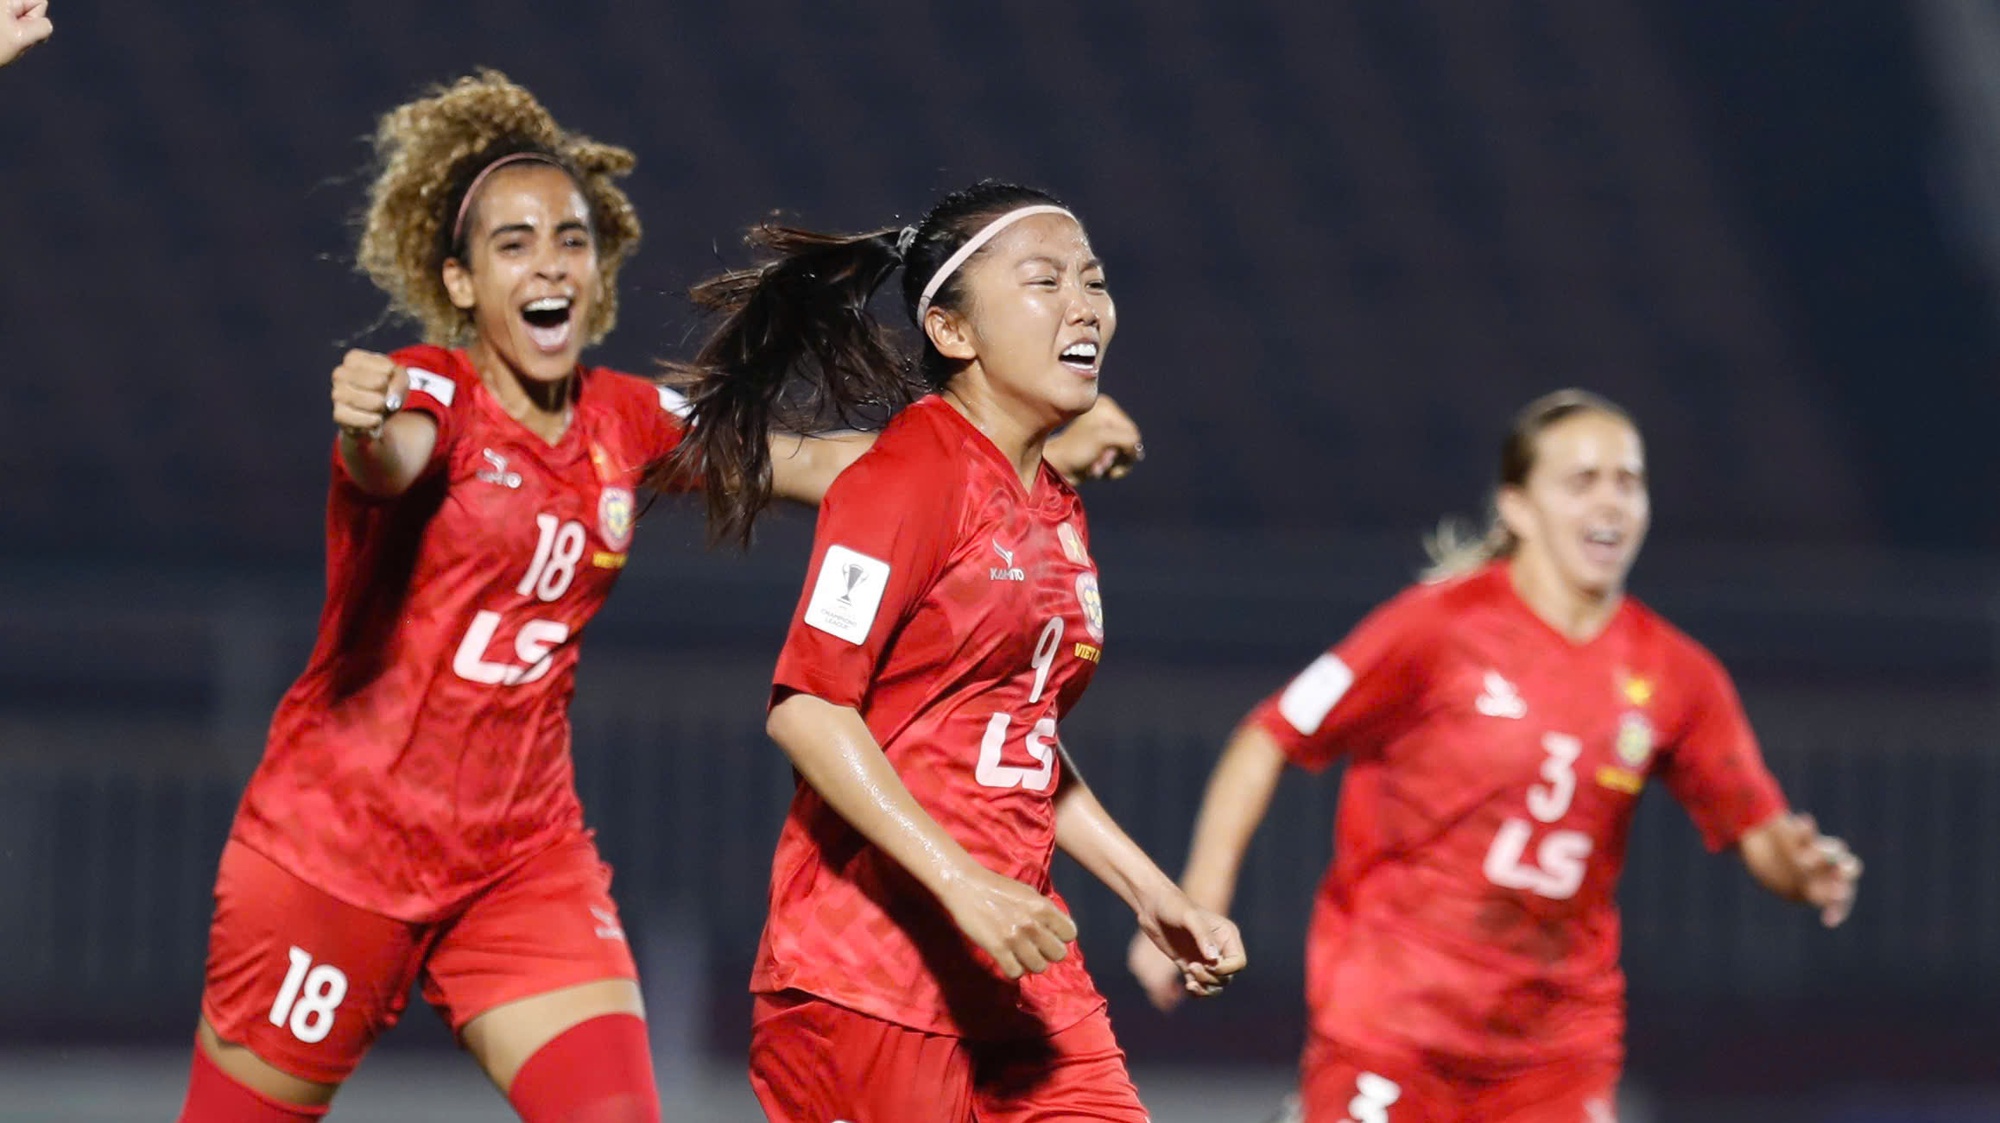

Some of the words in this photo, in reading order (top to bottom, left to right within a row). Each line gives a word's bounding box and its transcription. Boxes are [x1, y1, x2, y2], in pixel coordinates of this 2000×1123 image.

[516, 513, 587, 602] 18
[453, 610, 569, 686] LS
[1028, 616, 1065, 703] 9
[1074, 641, 1096, 662] VIET
[975, 712, 1057, 791] LS
[1526, 730, 1583, 823] 3
[1483, 817, 1594, 900] LS
[268, 946, 348, 1043] 18
